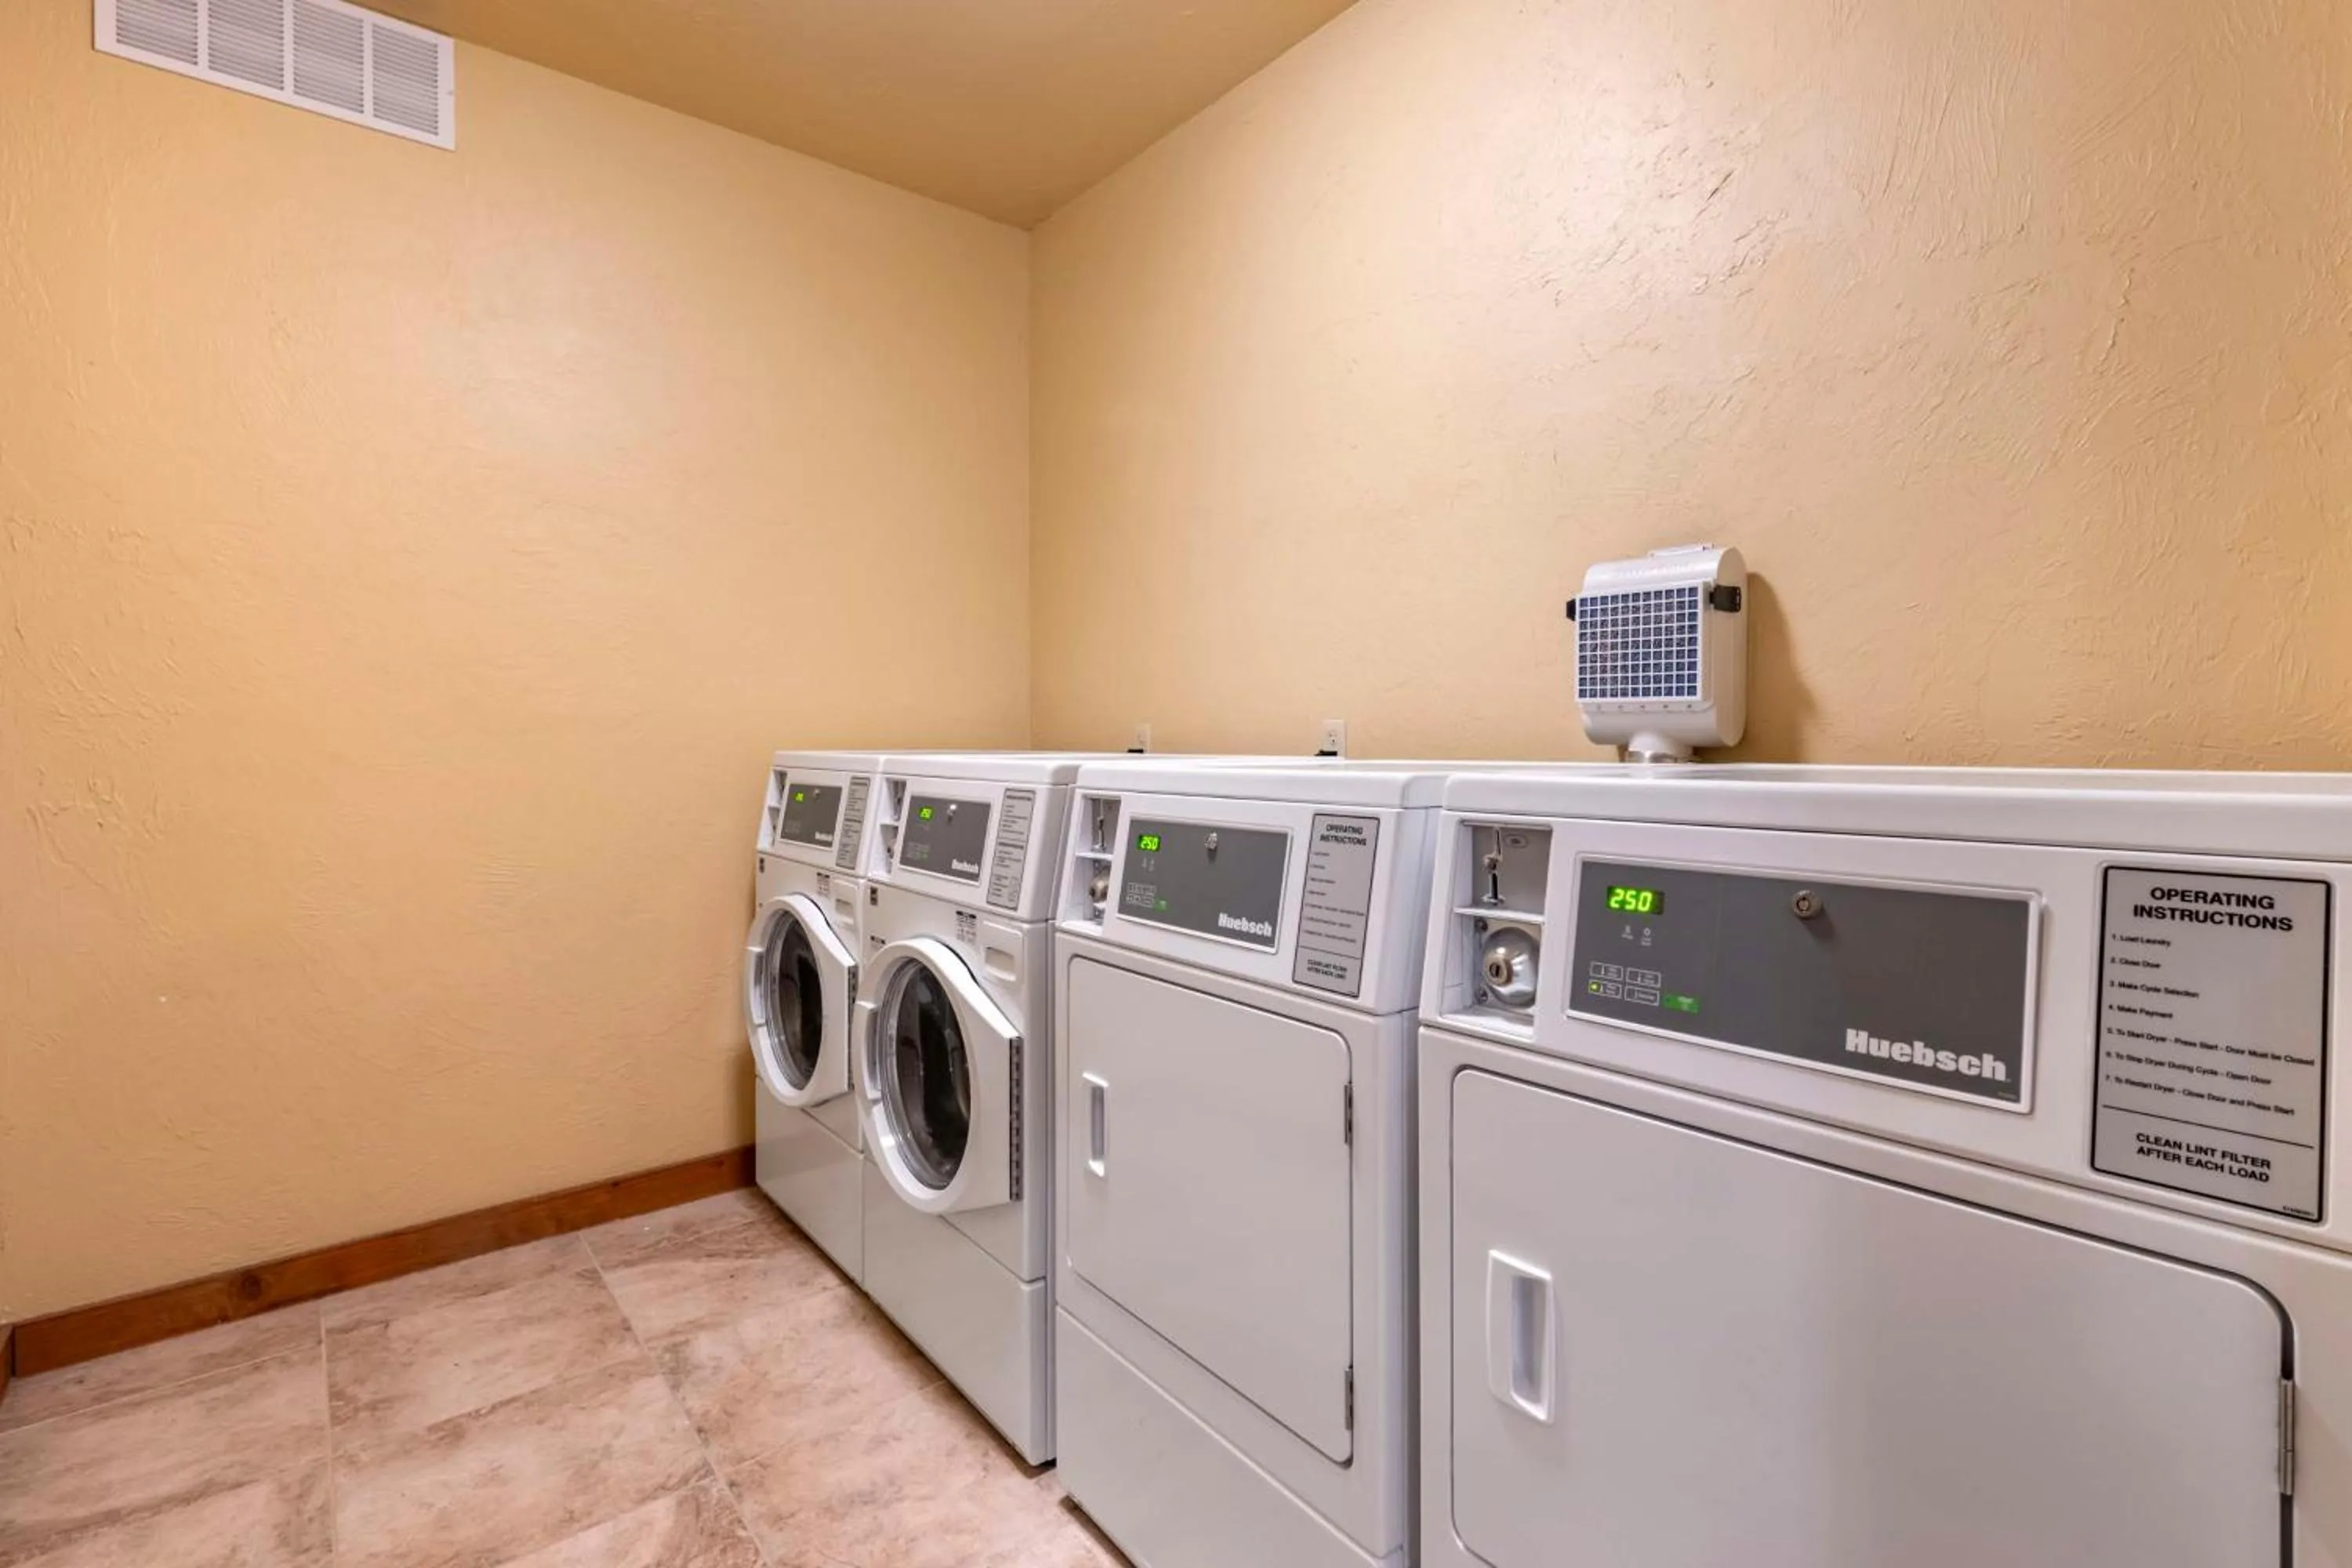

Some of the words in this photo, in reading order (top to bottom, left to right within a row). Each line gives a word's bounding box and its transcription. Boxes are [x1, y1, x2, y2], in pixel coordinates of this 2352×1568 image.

[1610, 888, 1653, 912] 250
[2150, 887, 2275, 909] OPERATING
[1218, 912, 1272, 938] Huebsch
[2133, 904, 2293, 931] INSTRUCTIONS
[2118, 981, 2139, 989] Make
[2140, 984, 2161, 993] Cycle
[2164, 987, 2199, 998] Selection
[2117, 1005, 2137, 1014] Make
[2139, 1008, 2173, 1018] Payment
[1845, 1028, 2007, 1082] Huebsch
[2136, 1132, 2183, 1151] CLEAN
[2186, 1142, 2218, 1158] LINT
[2221, 1150, 2272, 1171] FILTER
[2136, 1145, 2182, 1163] AFTER
[2185, 1155, 2225, 1173] EACH
[2229, 1166, 2270, 1183] LOAD
